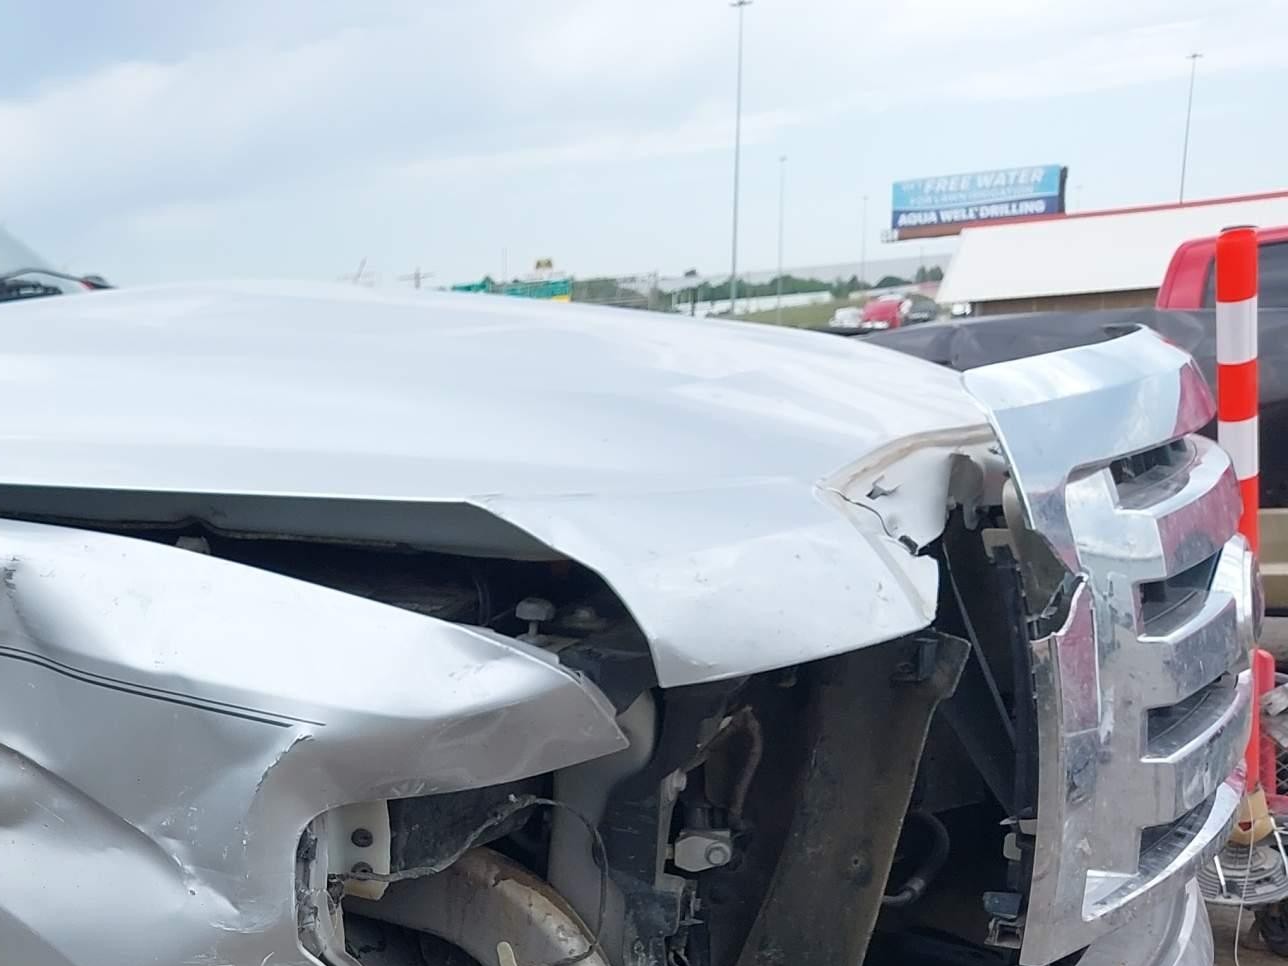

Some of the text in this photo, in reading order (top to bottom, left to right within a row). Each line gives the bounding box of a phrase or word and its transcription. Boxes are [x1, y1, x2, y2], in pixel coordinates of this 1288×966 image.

[922, 175, 970, 194] FREE
[976, 169, 1044, 189] WATER
[897, 199, 1045, 227] AQUA WELL DRILLING
